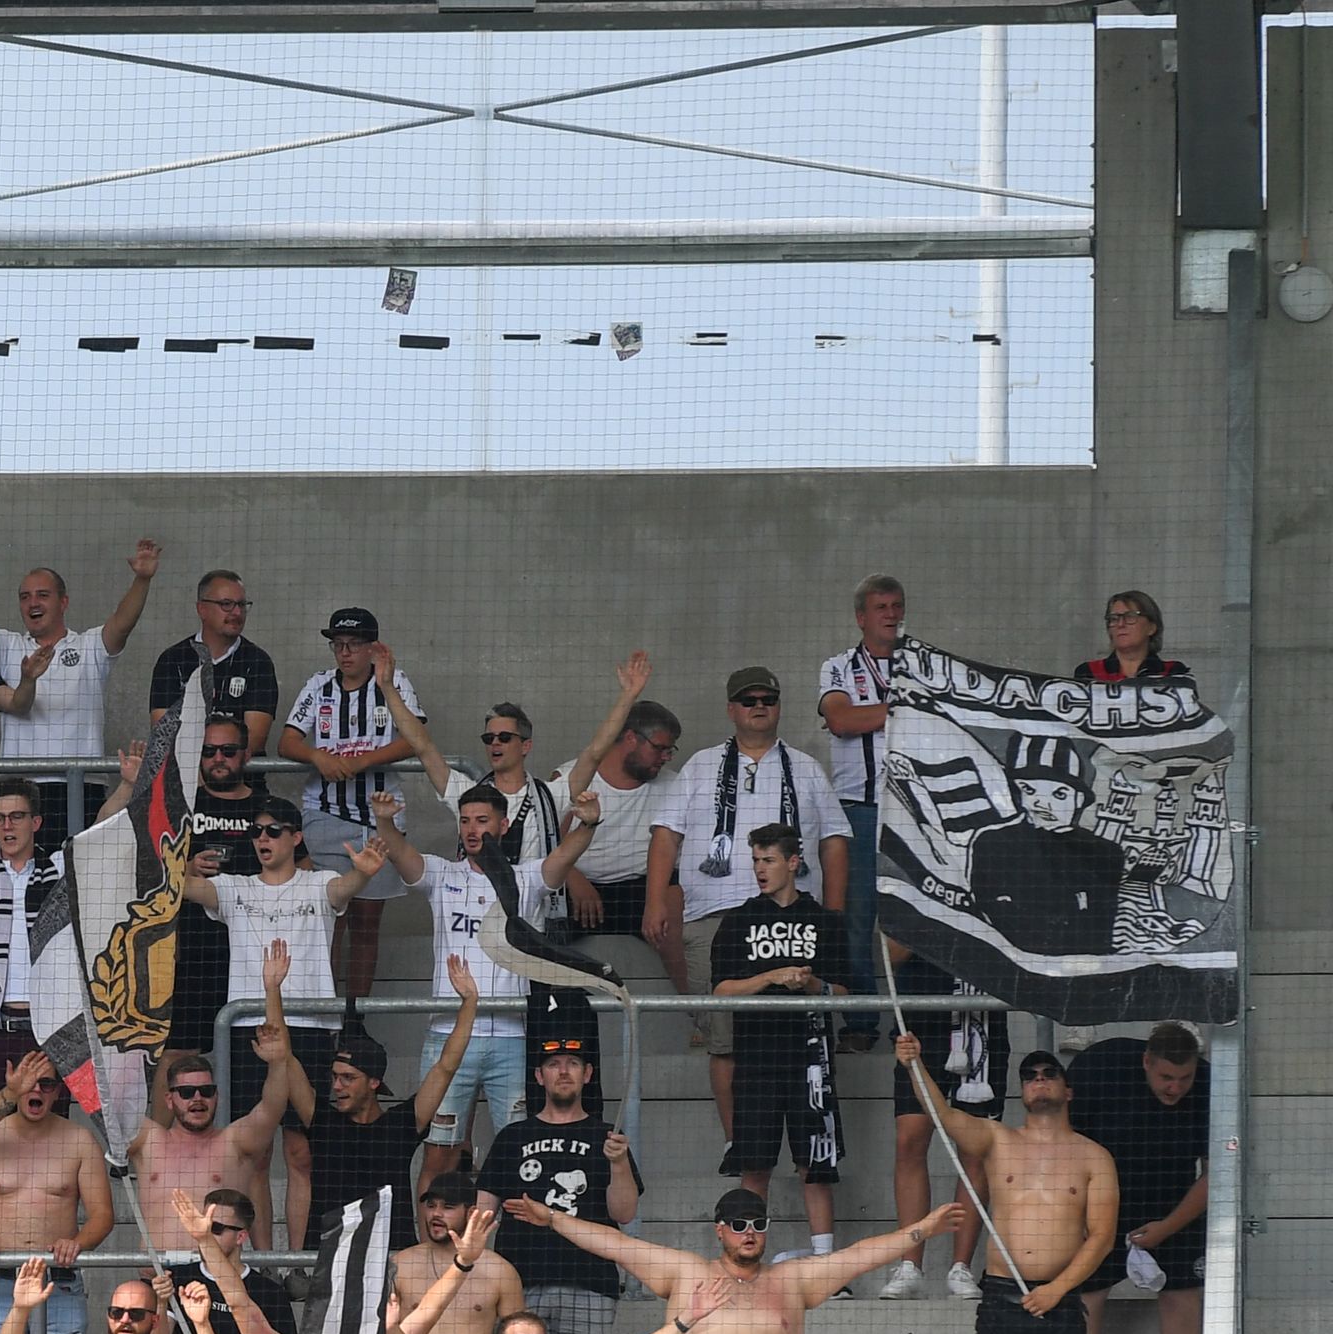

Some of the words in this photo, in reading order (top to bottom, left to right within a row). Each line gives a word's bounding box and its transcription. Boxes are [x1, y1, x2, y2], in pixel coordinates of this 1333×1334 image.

[292, 692, 314, 723] Zipfer
[921, 876, 970, 906] gegr.
[451, 912, 483, 938] Zip
[745, 921, 817, 943] JACK&
[747, 940, 817, 961] JONES
[522, 1138, 565, 1158] KICK
[570, 1139, 591, 1157] IT
